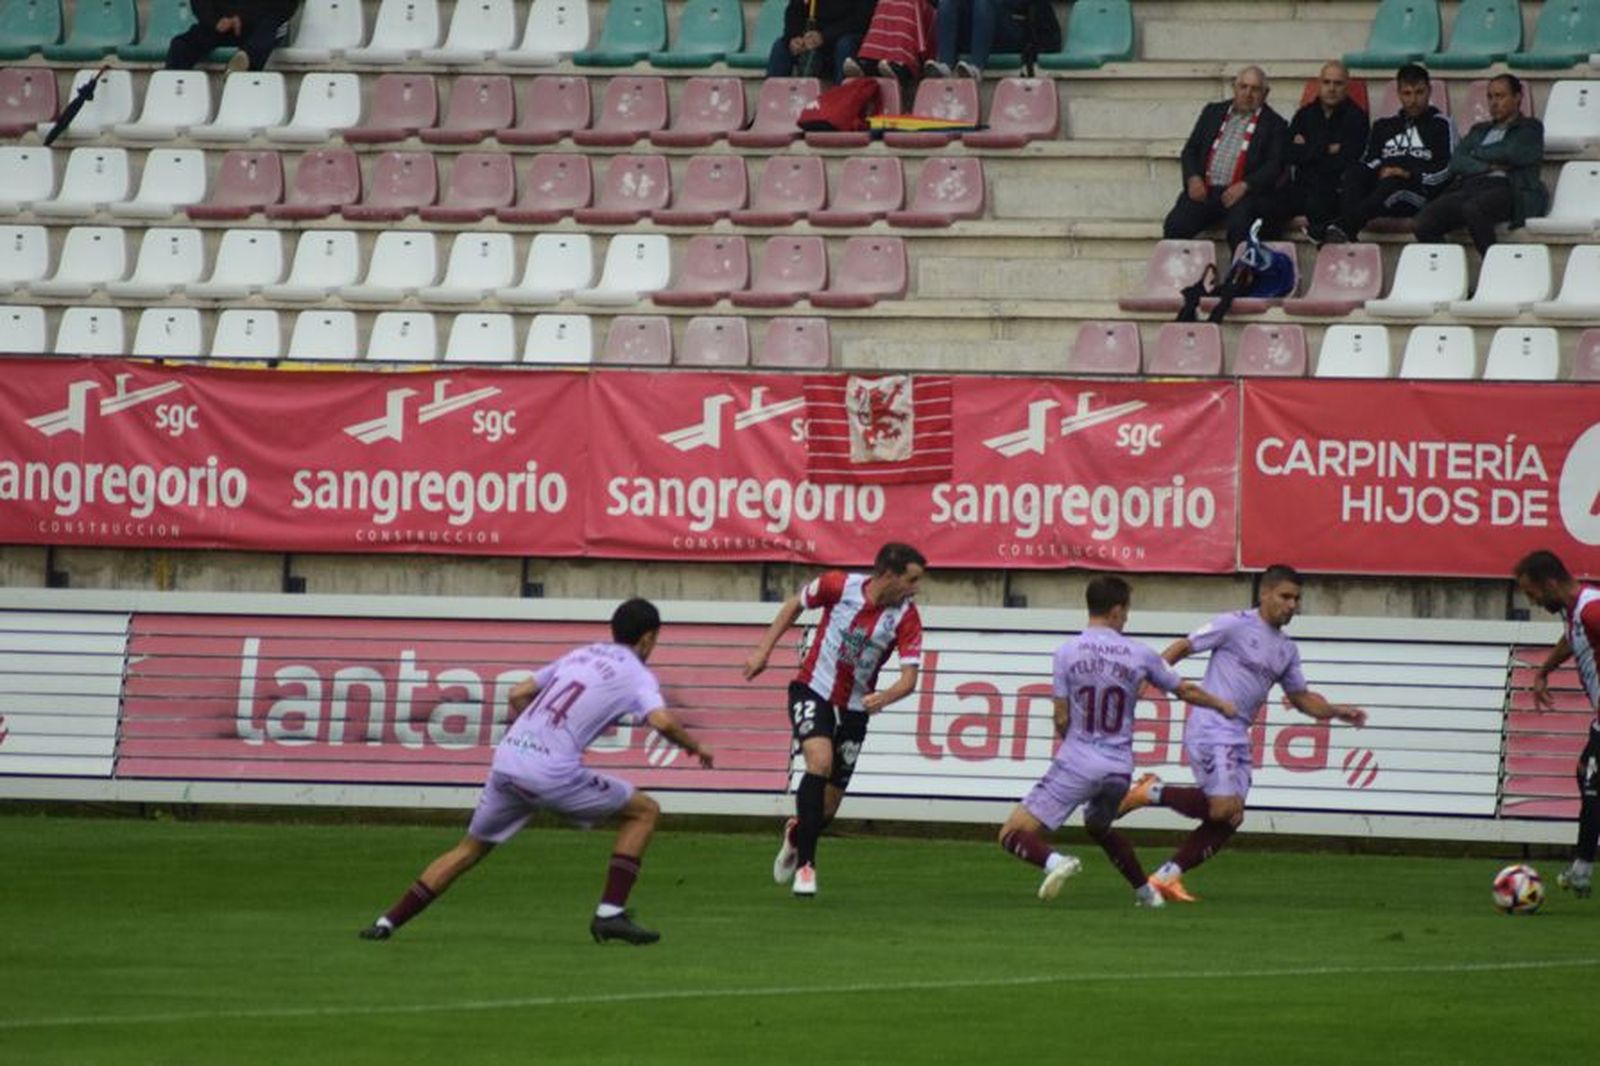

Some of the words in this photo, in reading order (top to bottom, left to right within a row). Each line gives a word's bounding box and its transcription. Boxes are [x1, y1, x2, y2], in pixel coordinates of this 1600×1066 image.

[155, 404, 199, 436] sgc
[472, 409, 517, 442] sgc
[1116, 422, 1162, 455] sgc
[1255, 434, 1549, 481] CARPINTERÍA
[0, 456, 247, 518] angregorio
[291, 460, 567, 525] sangregorio
[606, 475, 886, 533] sangregorio
[931, 474, 1215, 540] sangregorio
[1342, 485, 1480, 525] HIJOS
[1491, 488, 1549, 526] DE
[528, 677, 587, 726] 14
[1076, 685, 1125, 734] 10
